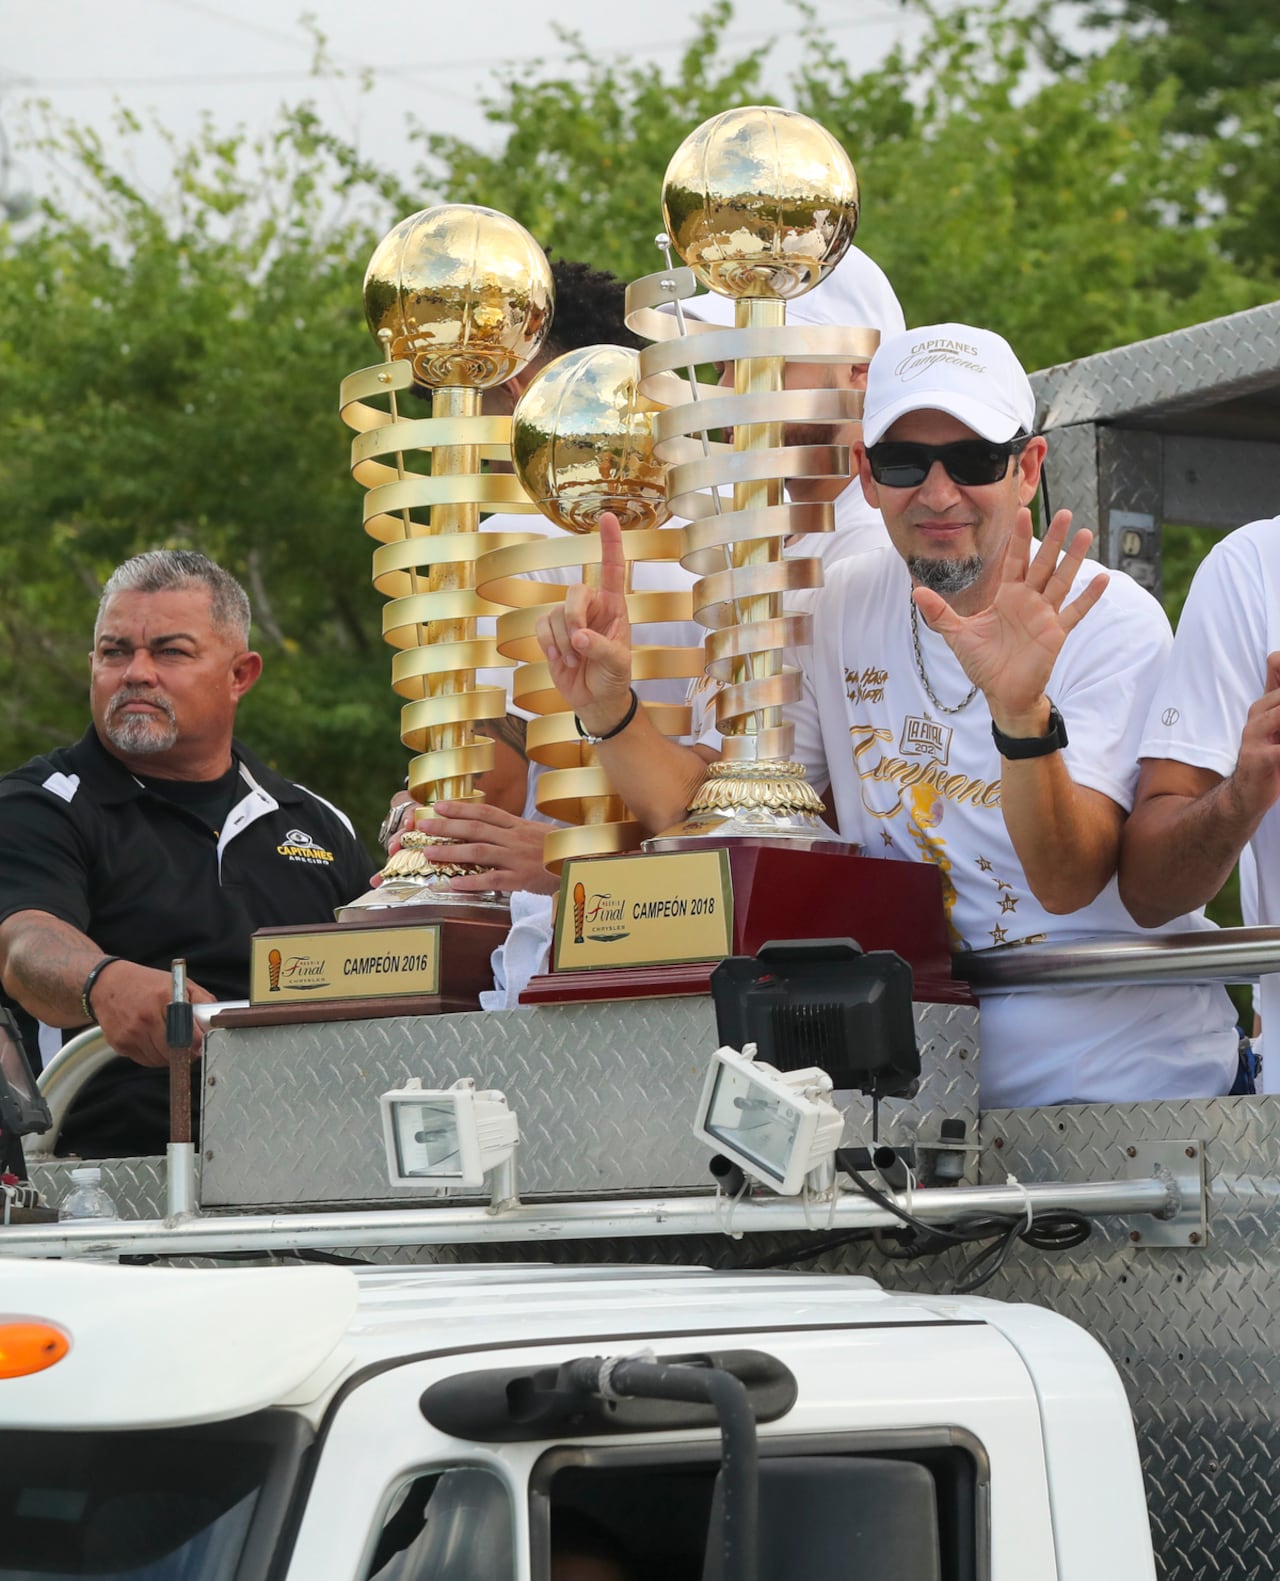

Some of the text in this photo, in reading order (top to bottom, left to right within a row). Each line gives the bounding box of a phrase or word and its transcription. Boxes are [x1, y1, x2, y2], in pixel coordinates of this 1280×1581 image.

[911, 339, 978, 356] CAPITANES
[895, 353, 987, 383] Campeones
[277, 845, 335, 862] CAPITANES
[586, 893, 626, 923] Final
[632, 896, 715, 920] CAMPEÓN 2018
[281, 956, 326, 978] Final
[343, 952, 428, 976] CAMPEÓN 2016
